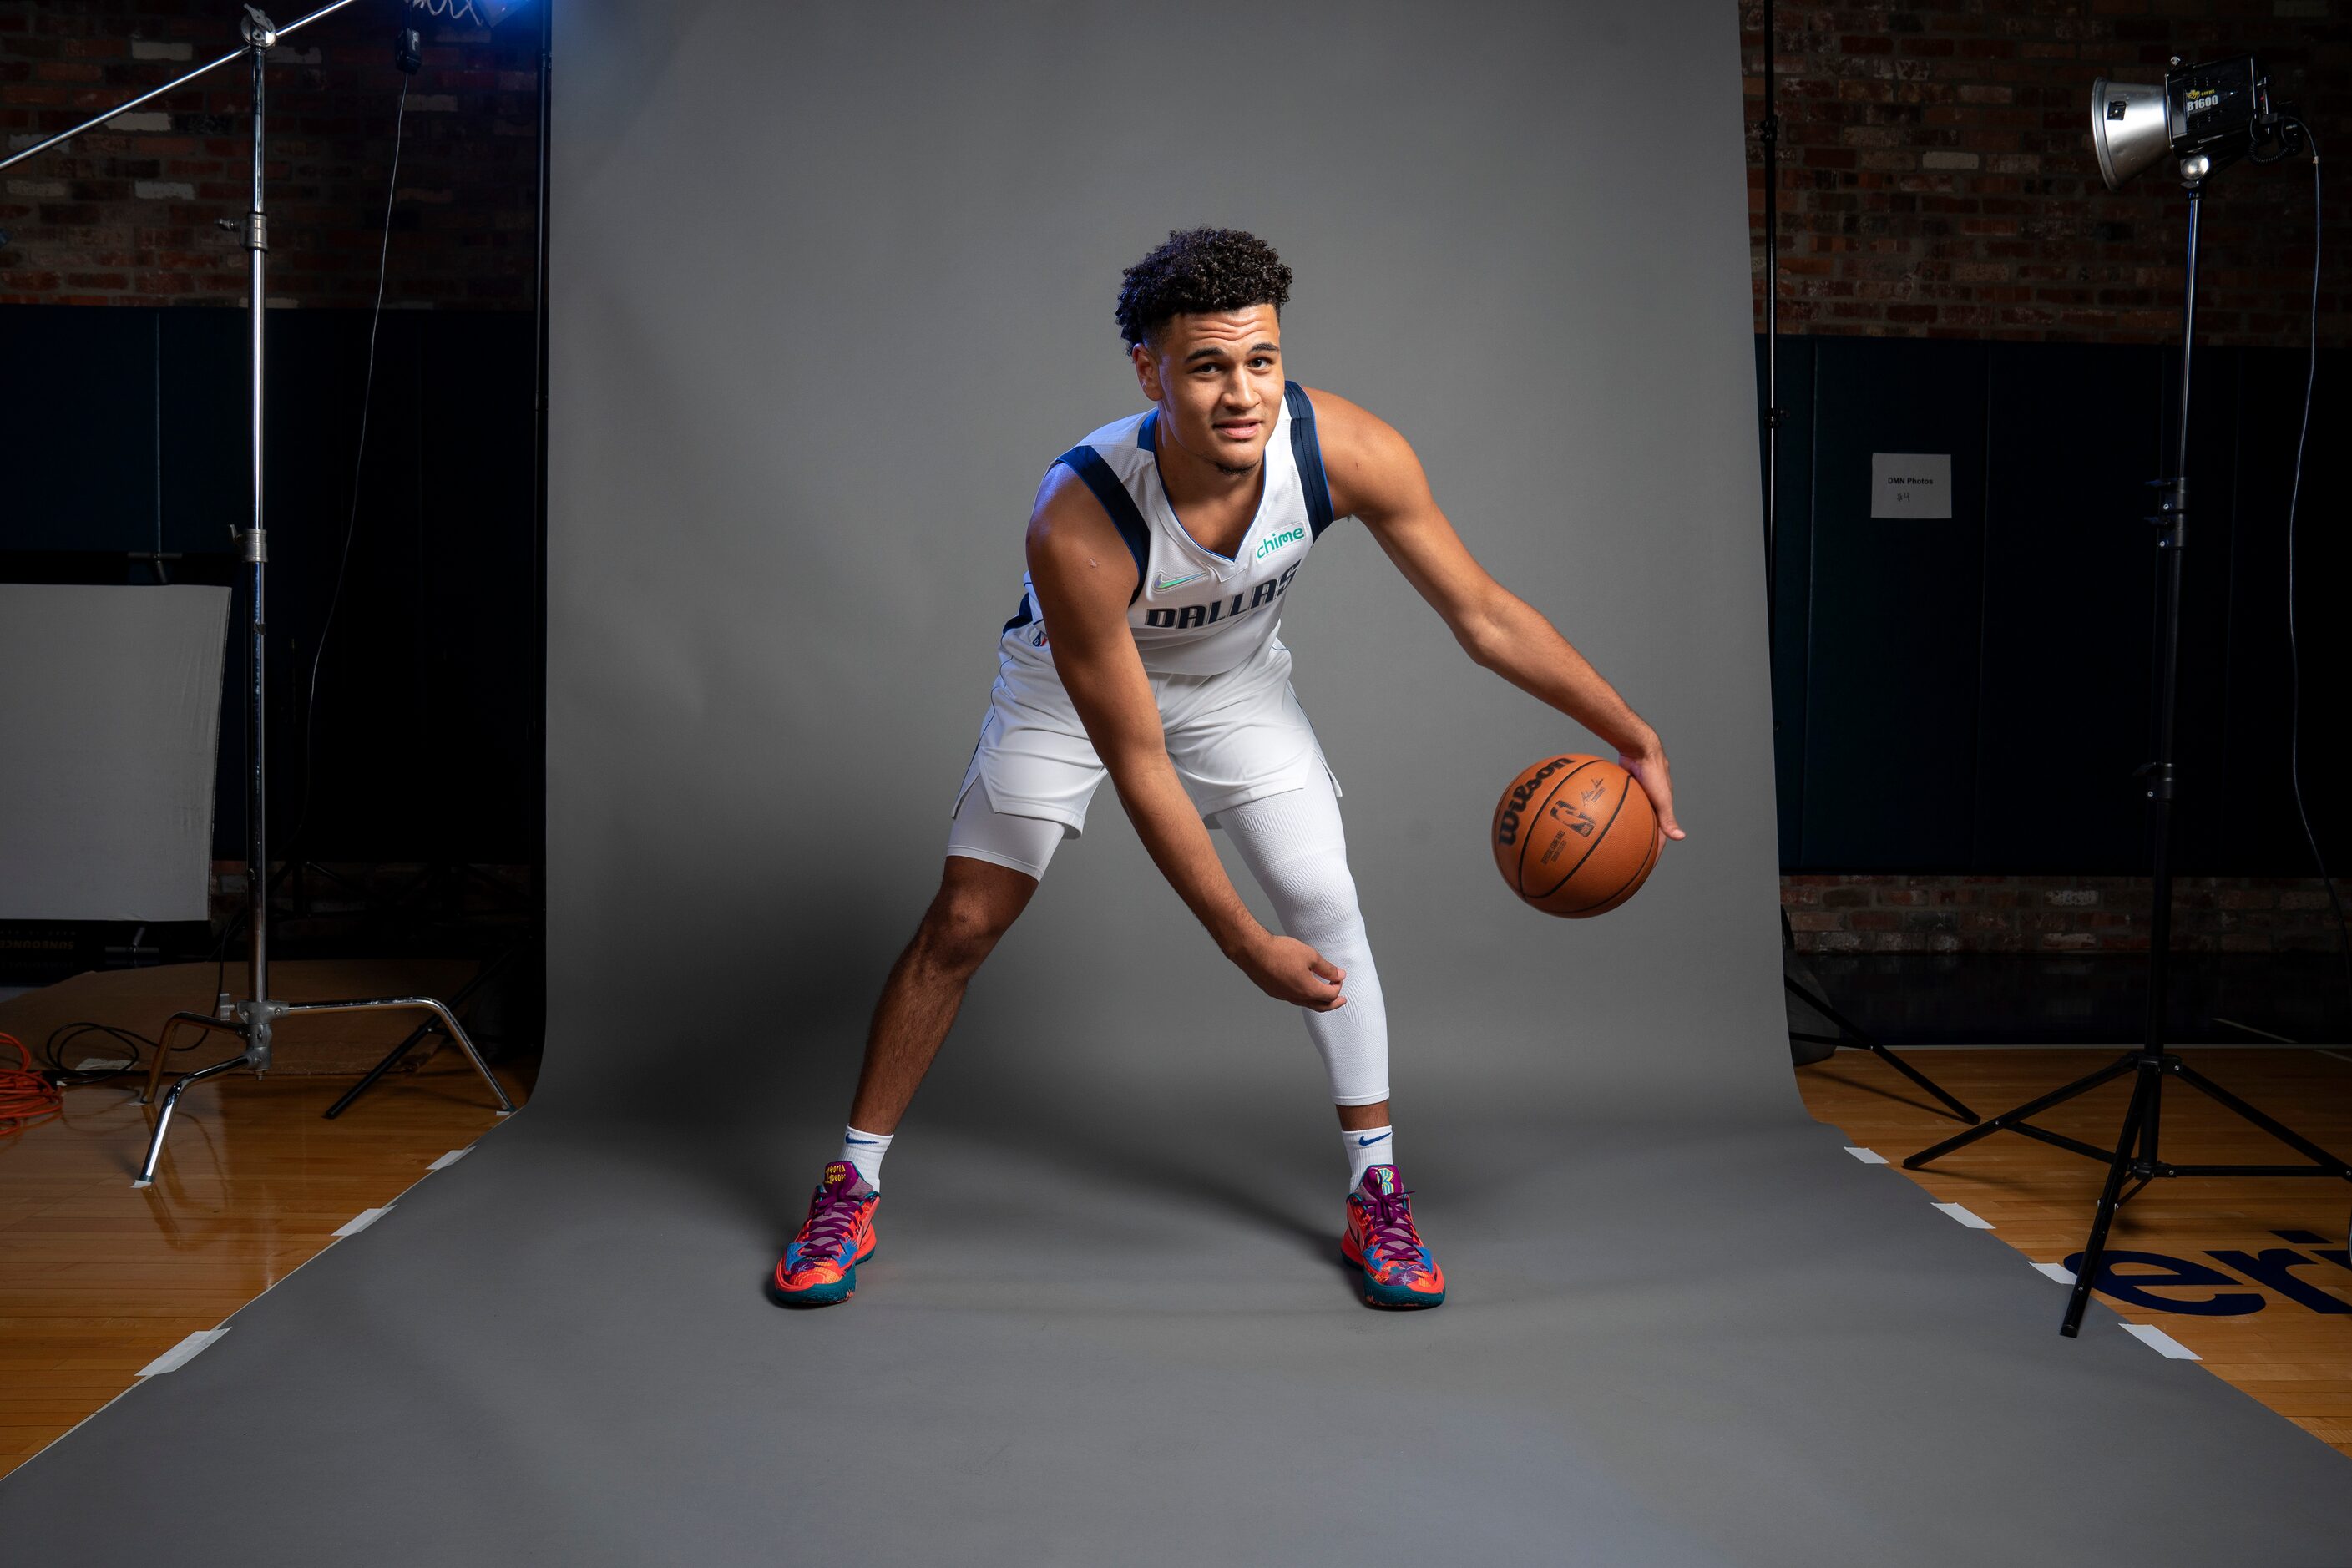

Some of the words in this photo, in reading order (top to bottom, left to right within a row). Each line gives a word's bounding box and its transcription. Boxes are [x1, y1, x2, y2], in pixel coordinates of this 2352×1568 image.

[2186, 94, 2218, 112] B1600
[1256, 525, 1305, 559] chime
[1145, 559, 1302, 629] DALLAS
[1498, 757, 1576, 846] Wilson
